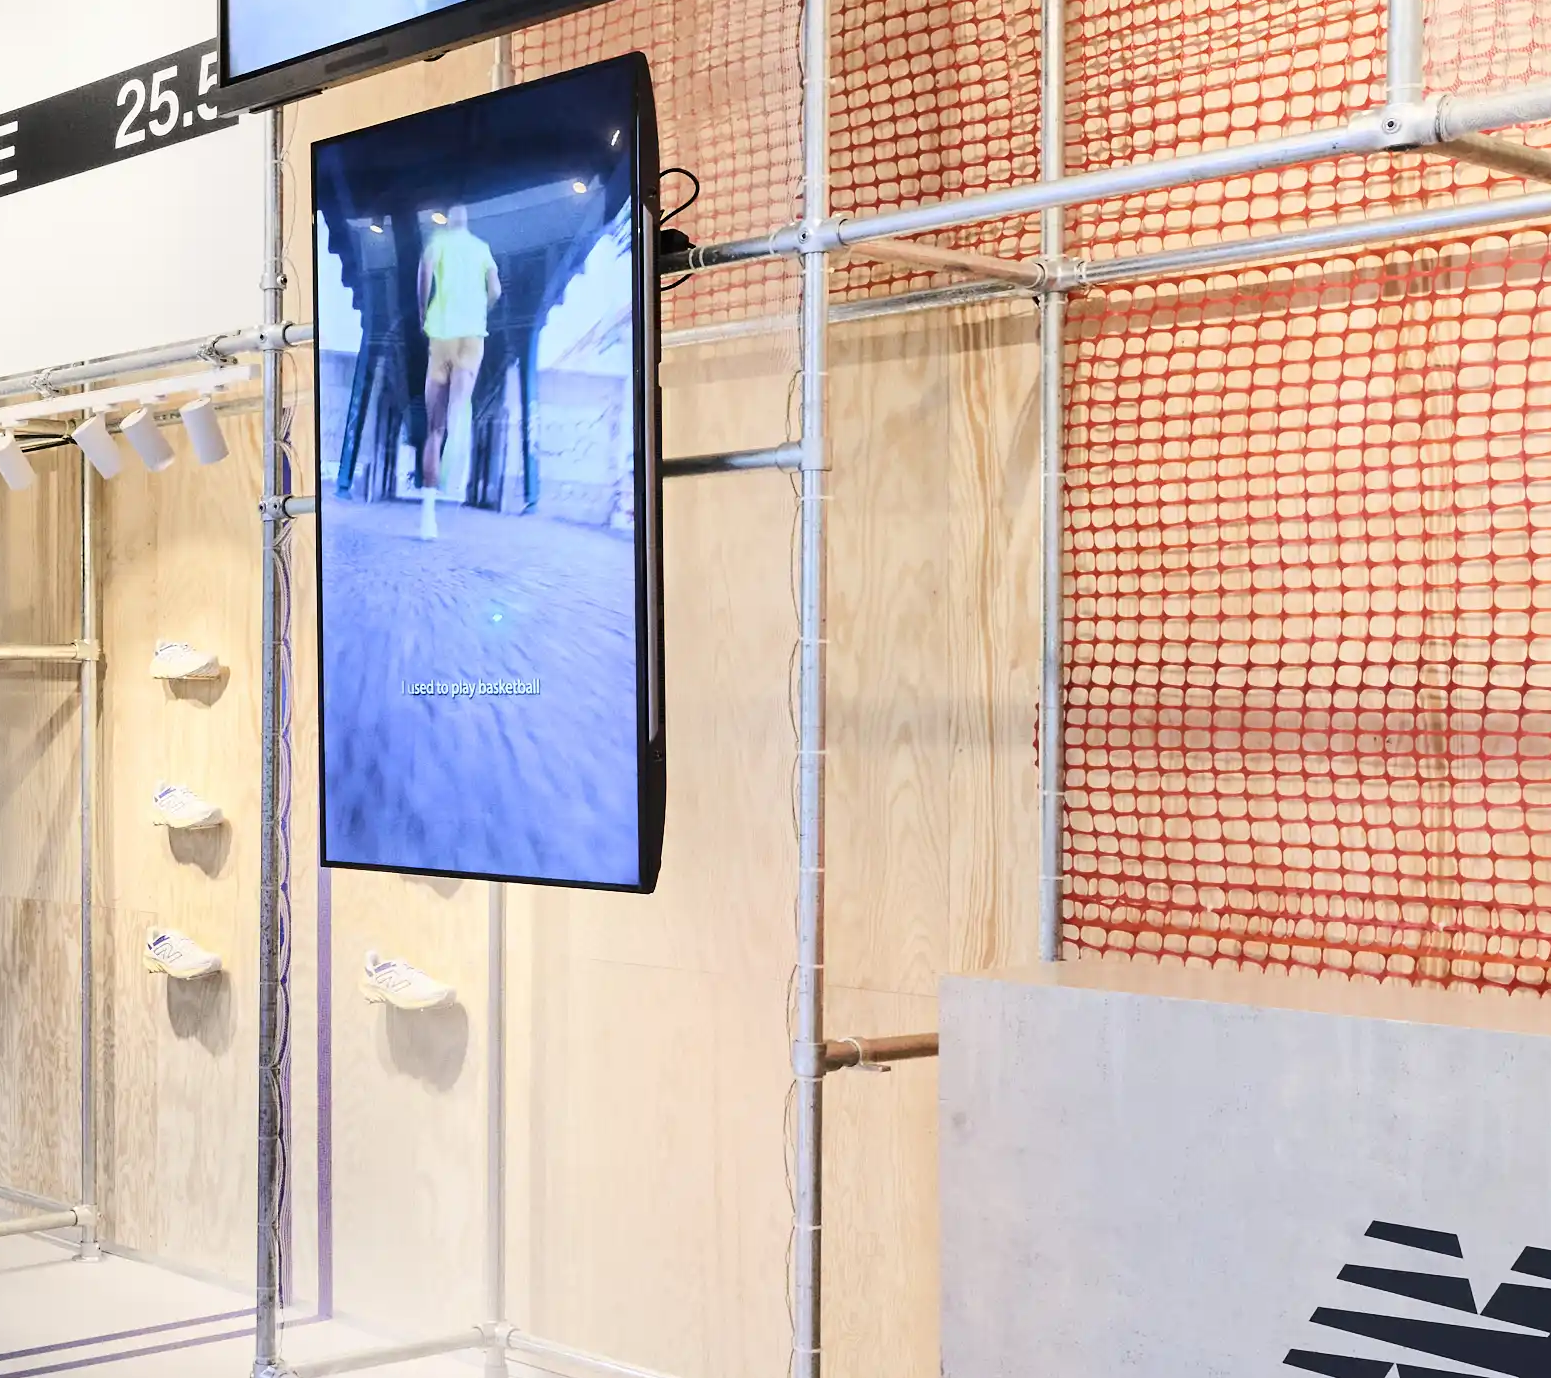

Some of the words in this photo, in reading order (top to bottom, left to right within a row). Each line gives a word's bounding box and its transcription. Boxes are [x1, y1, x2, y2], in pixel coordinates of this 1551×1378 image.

[408, 680, 434, 695] used
[437, 681, 448, 695] to
[452, 679, 476, 698] play
[479, 679, 540, 695] basketball
